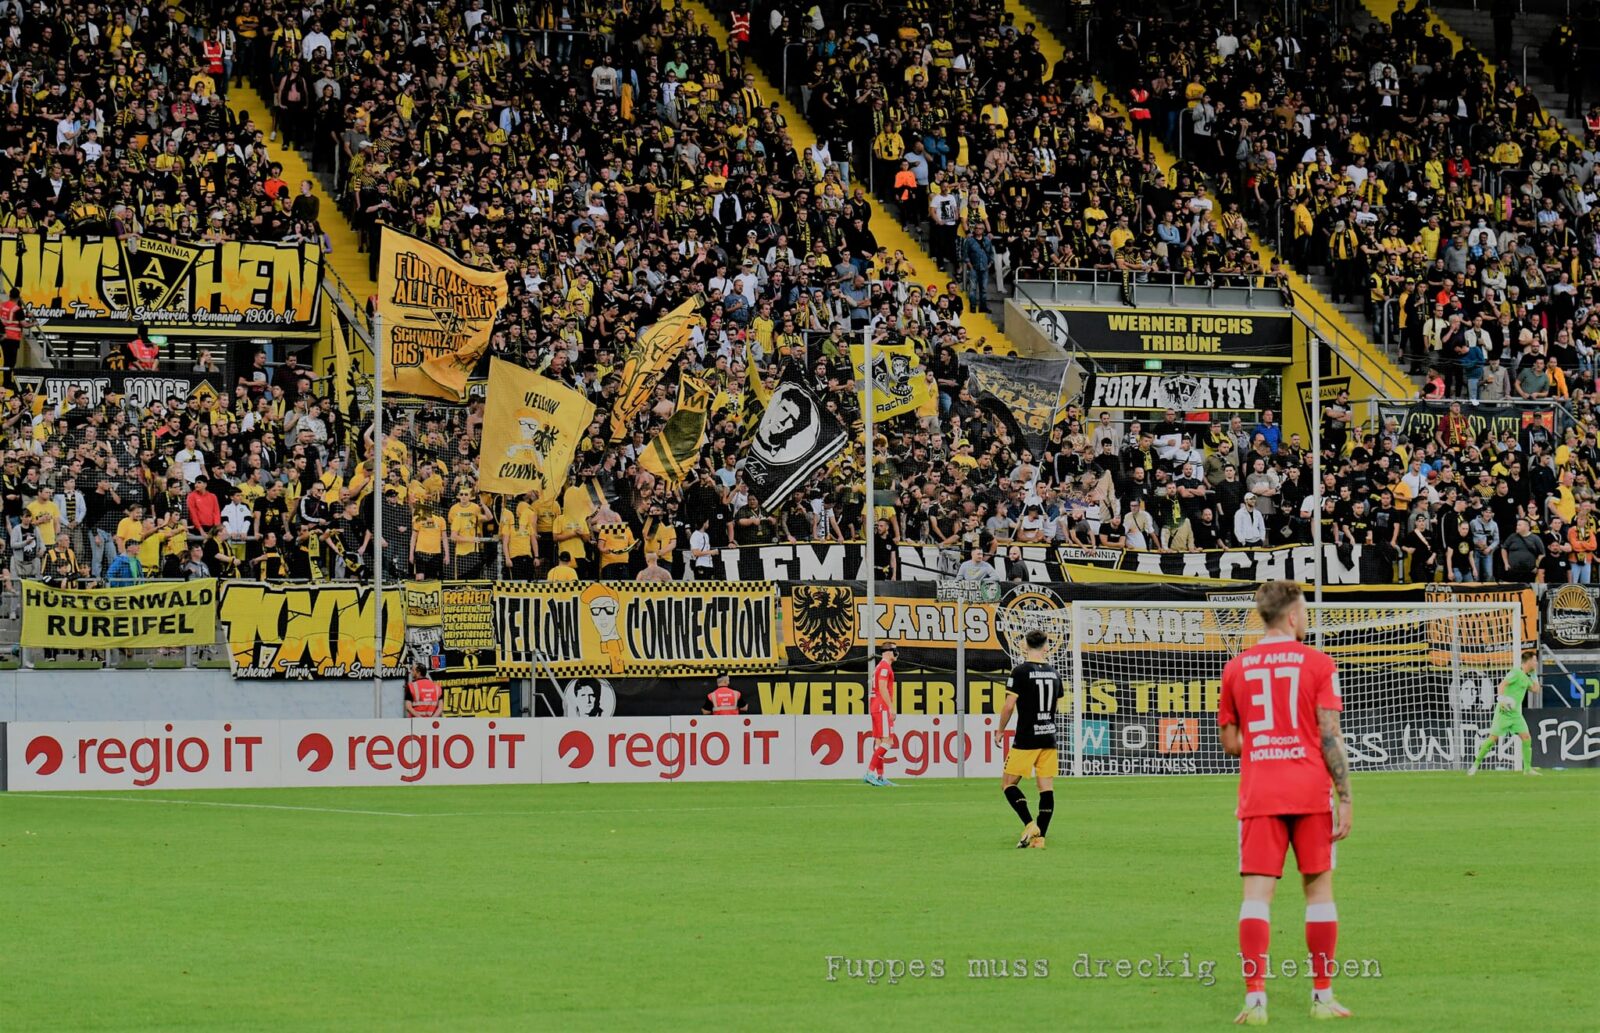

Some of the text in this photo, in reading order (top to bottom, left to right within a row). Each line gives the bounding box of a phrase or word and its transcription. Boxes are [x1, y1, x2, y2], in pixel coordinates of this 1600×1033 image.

[138, 238, 191, 260] EMANNIA
[395, 251, 431, 284] FÜR
[393, 279, 448, 308] ALLES
[1107, 314, 1253, 335] WERNER FUCHS
[392, 342, 419, 366] BIS
[1140, 333, 1222, 353] TRIBÜNE
[524, 391, 560, 415] YELLOW
[1092, 375, 1161, 408] FORZA
[1197, 375, 1259, 409] ATSV
[1062, 549, 1117, 561] ALEMANNIA
[25, 588, 211, 612] HÜRTGENWALD
[443, 590, 491, 605] FREIHEIT
[47, 613, 194, 637] RUREIFEL
[443, 613, 491, 623] SICHERHEIT
[494, 596, 771, 662] YELLOW CONNECTION
[858, 603, 990, 643] KARLS
[1264, 652, 1304, 665] AHLEN
[1035, 679, 1053, 712] 11
[1244, 667, 1301, 733] 37
[78, 723, 209, 787] regio
[348, 720, 475, 783] regio
[608, 718, 731, 779] regio
[1249, 746, 1306, 762] HOLLDACK
[1070, 758, 1118, 774] ORLD
